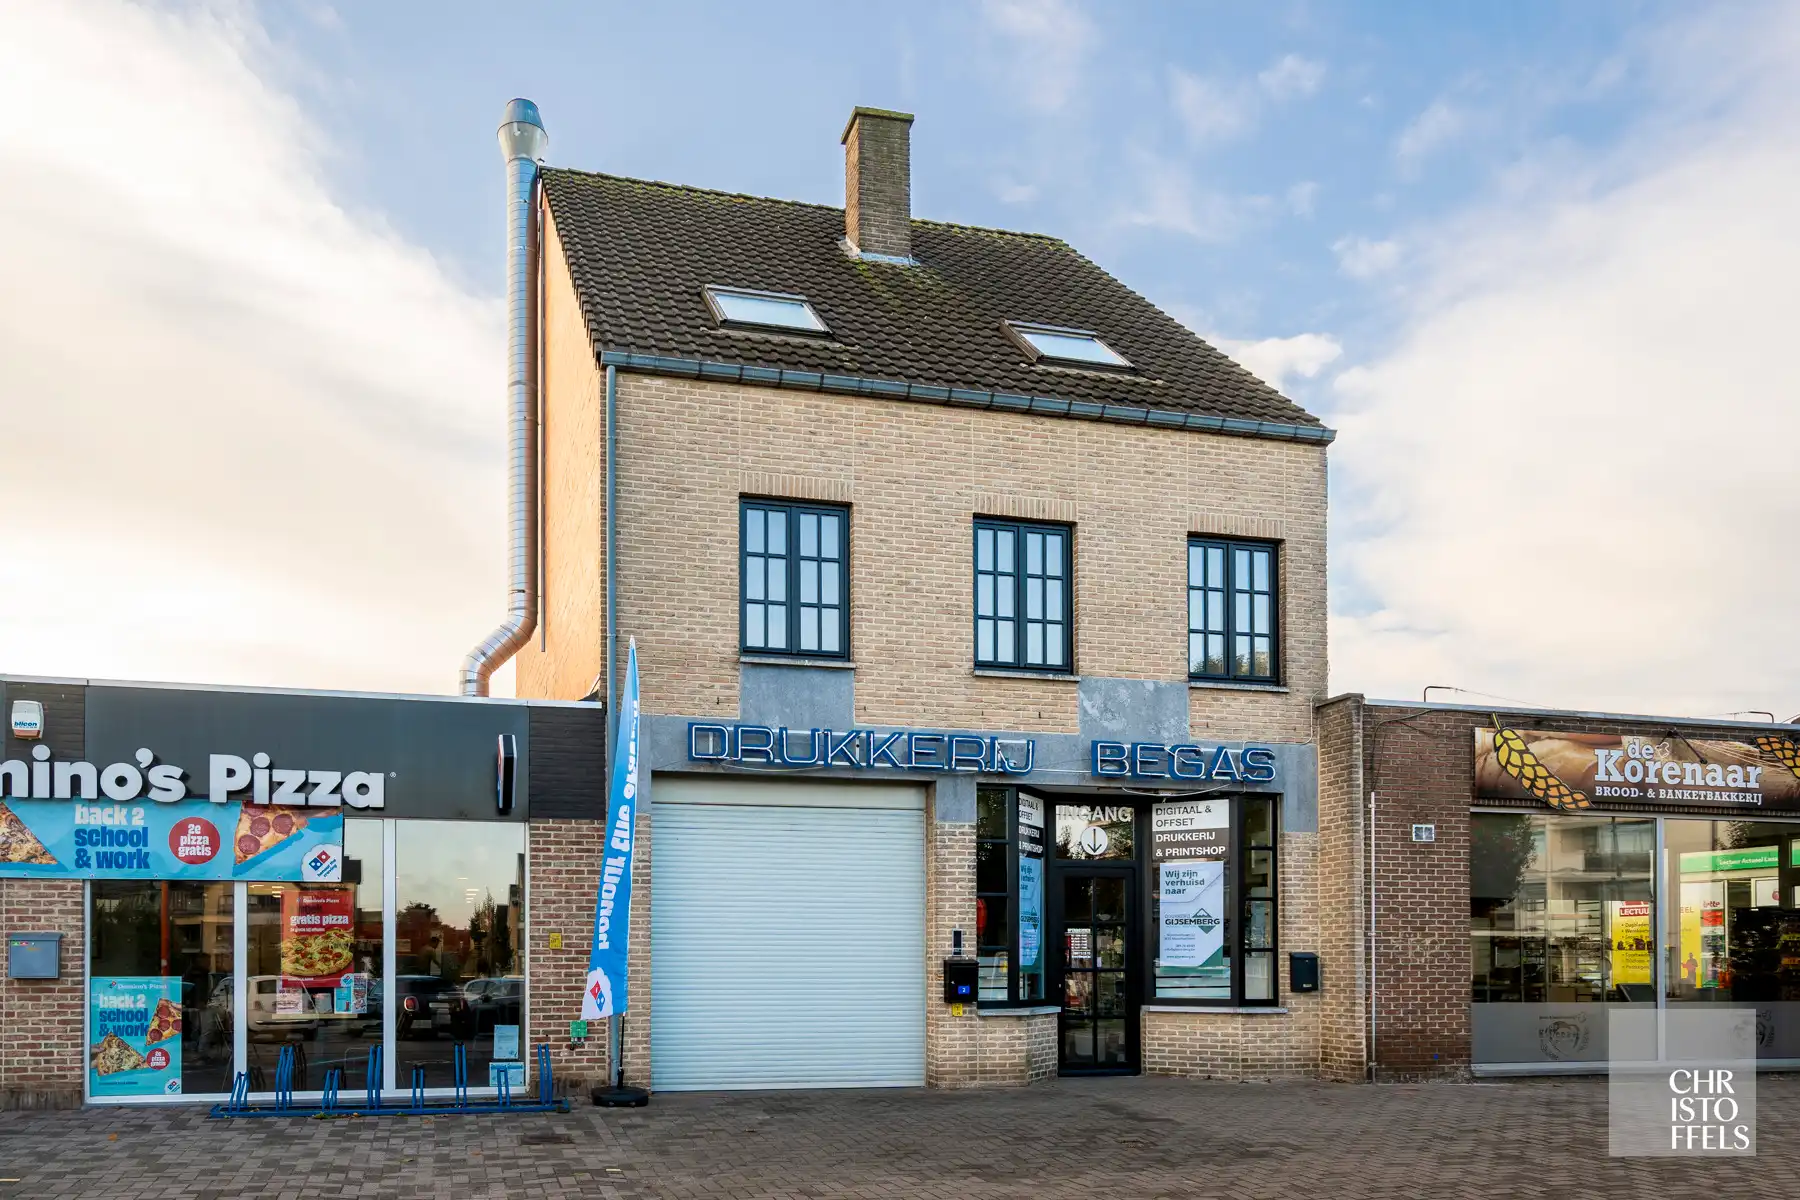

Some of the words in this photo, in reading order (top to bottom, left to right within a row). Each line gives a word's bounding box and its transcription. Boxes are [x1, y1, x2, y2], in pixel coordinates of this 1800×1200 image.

[688, 722, 1035, 776] DRUKKERIJ
[1091, 740, 1275, 784] BEGAS
[1627, 738, 1654, 760] de
[1594, 749, 1762, 789] Korenaar
[210, 752, 384, 808] Pizza
[1595, 786, 1644, 798] BROOD-
[1647, 788, 1656, 799] &
[1659, 789, 1763, 805] BANKETBAKKERIJ
[74, 804, 128, 825] back
[131, 807, 145, 825] 2
[1058, 805, 1132, 822] INGANG
[1155, 805, 1202, 816] DIGITAAL
[1205, 805, 1212, 813] &
[187, 823, 201, 834] 2e
[1155, 818, 1195, 828] OFFSET
[74, 826, 149, 848] school
[180, 834, 209, 846] pizza
[1155, 832, 1216, 843] DRUKKERIJ
[178, 845, 212, 857] gratis
[1155, 848, 1163, 857] &
[1165, 846, 1226, 857] PRINTSHOP
[74, 848, 92, 869] &
[96, 848, 150, 869] work
[1165, 870, 1180, 879] Wij
[1182, 870, 1198, 879] zijn
[1165, 878, 1205, 886] verhuisd
[1165, 887, 1187, 895] naar
[290, 914, 320, 926] gratis
[322, 914, 349, 926] pizza
[1165, 918, 1220, 926] GIJSEMBERG
[99, 994, 135, 1008] back
[137, 993, 146, 1008] 2
[99, 1008, 149, 1022] school
[99, 1023, 112, 1037] &
[113, 1022, 149, 1037] work
